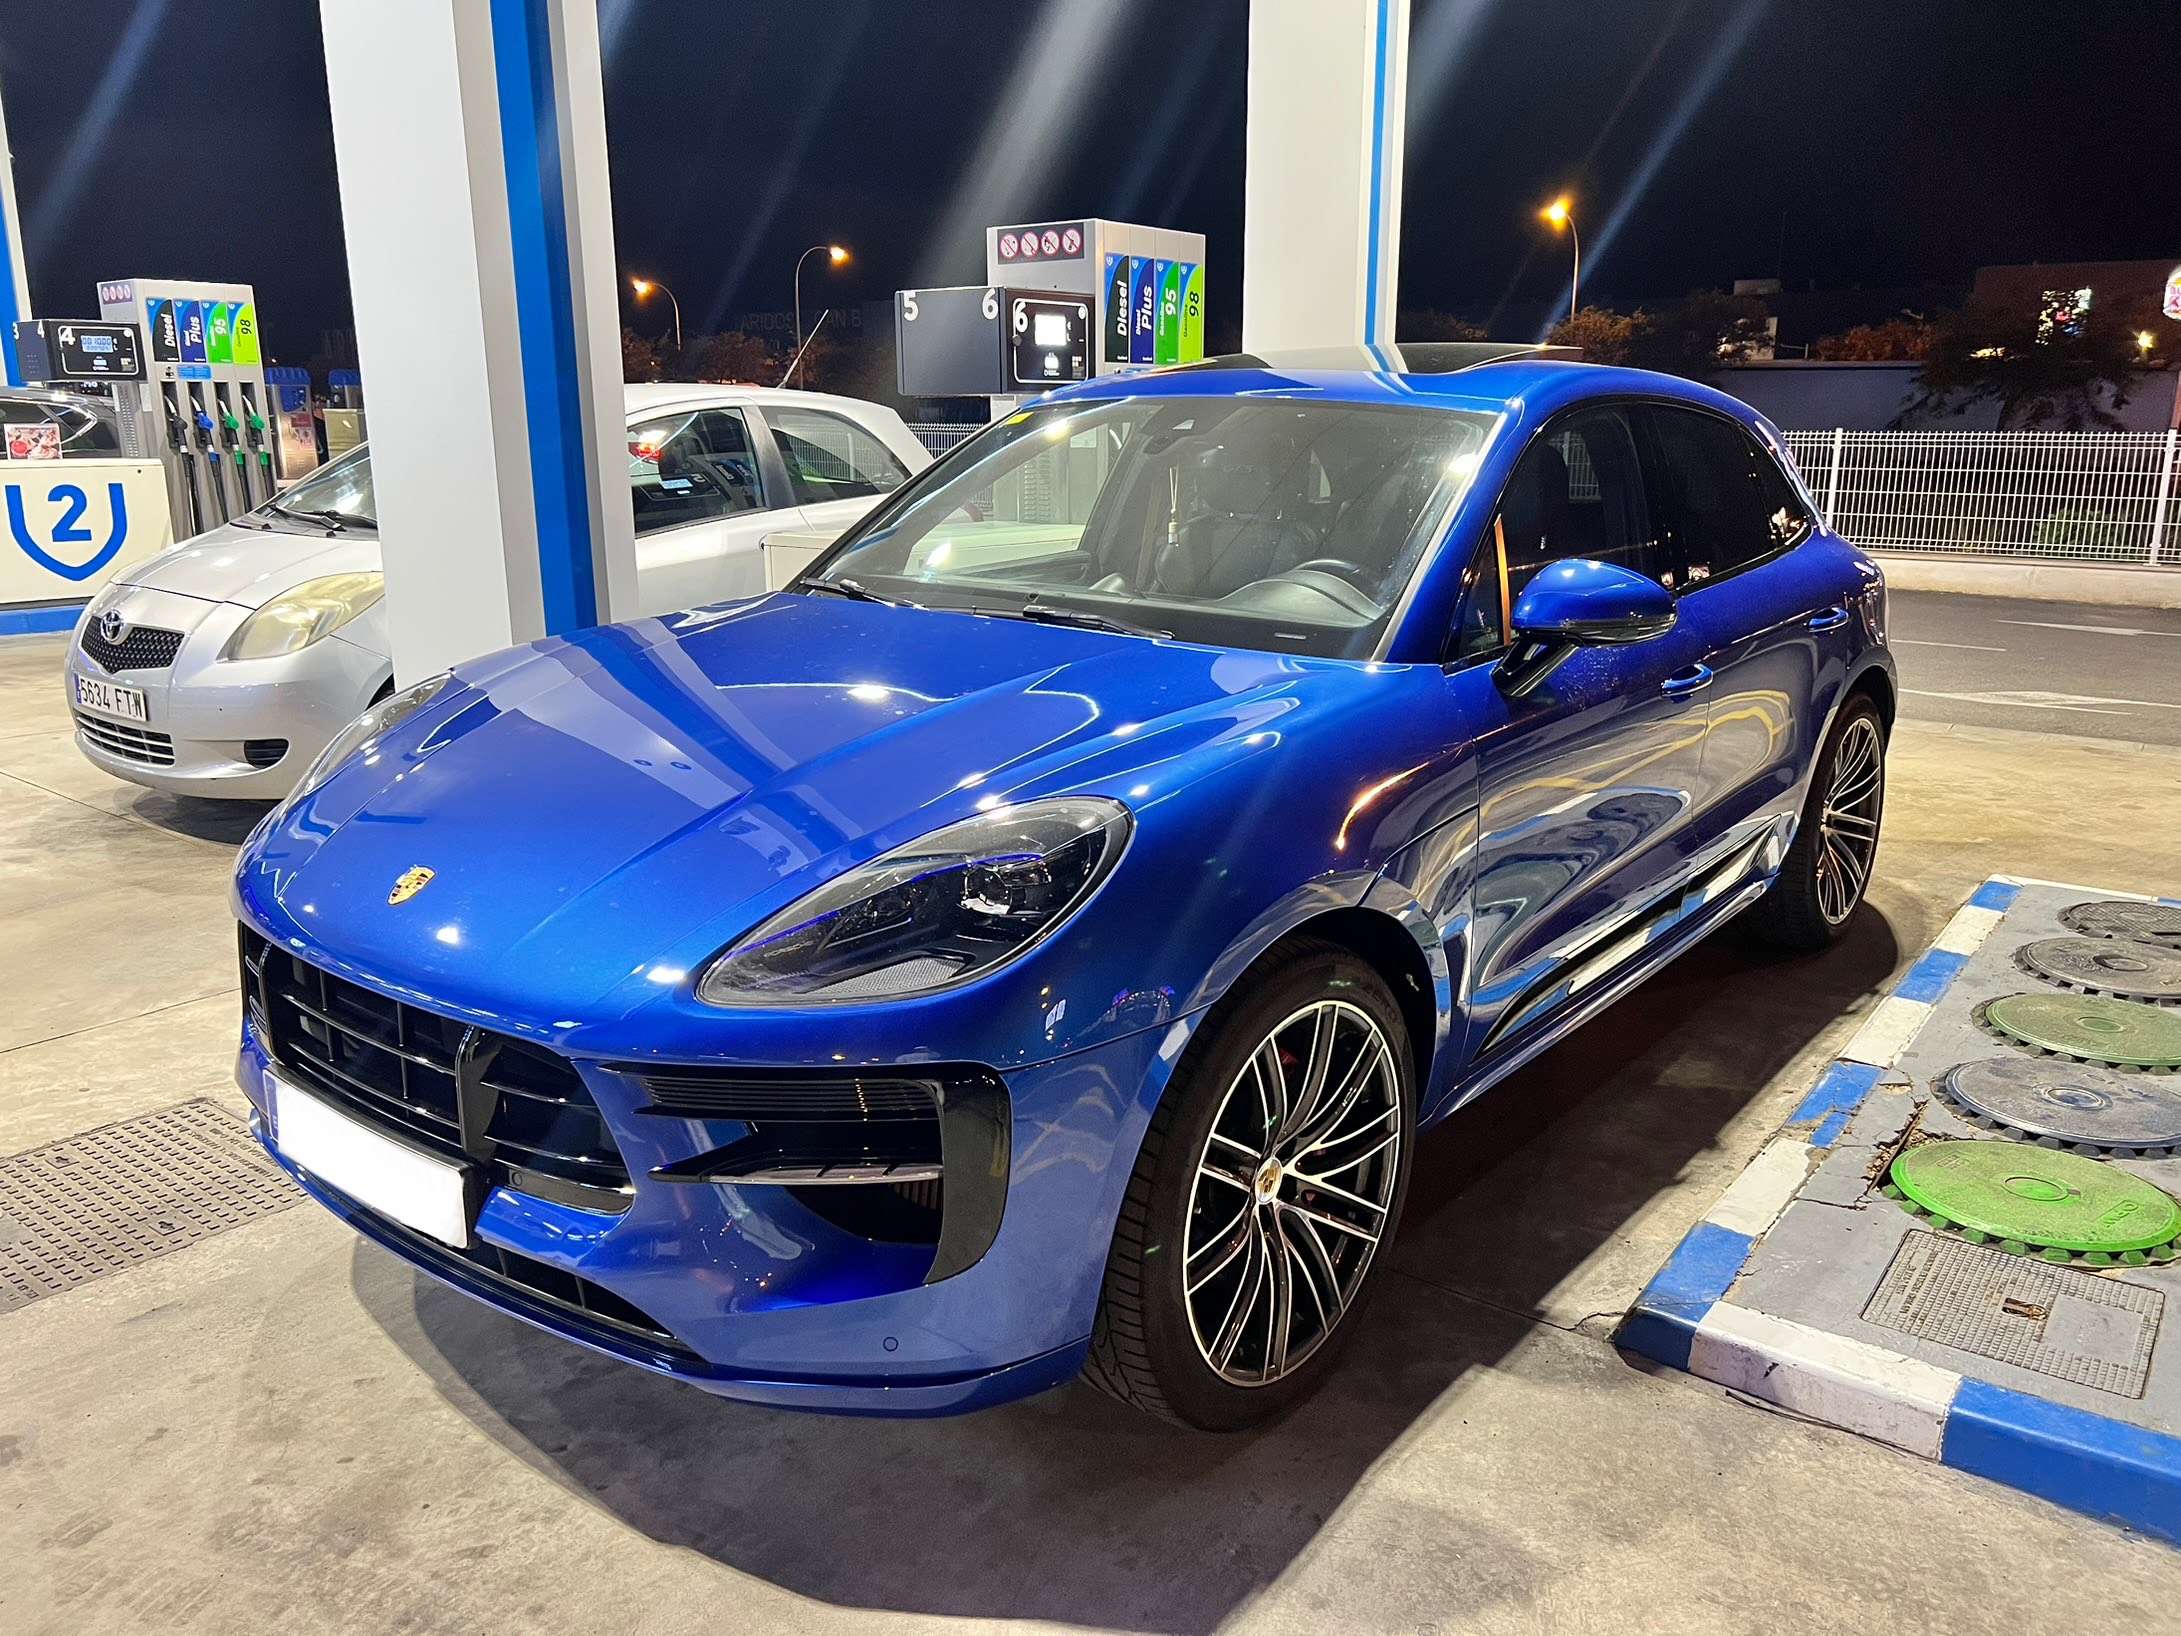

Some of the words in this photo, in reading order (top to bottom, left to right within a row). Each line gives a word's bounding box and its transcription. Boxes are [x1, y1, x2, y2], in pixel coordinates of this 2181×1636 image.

[903, 290, 919, 321] 5
[982, 287, 999, 320] 6
[1117, 280, 1128, 336] Diesel
[1141, 285, 1153, 330] Plus
[1165, 287, 1177, 315] 95
[1189, 291, 1200, 318] 98
[12, 321, 19, 340] 3
[37, 320, 45, 338] 4
[160, 313, 176, 348] Diesel
[189, 316, 202, 344] Plus
[214, 317, 227, 335] 95
[239, 318, 252, 335] 98
[1015, 301, 1028, 333] 6
[60, 327, 76, 345] 4
[80, 678, 111, 710] 5634
